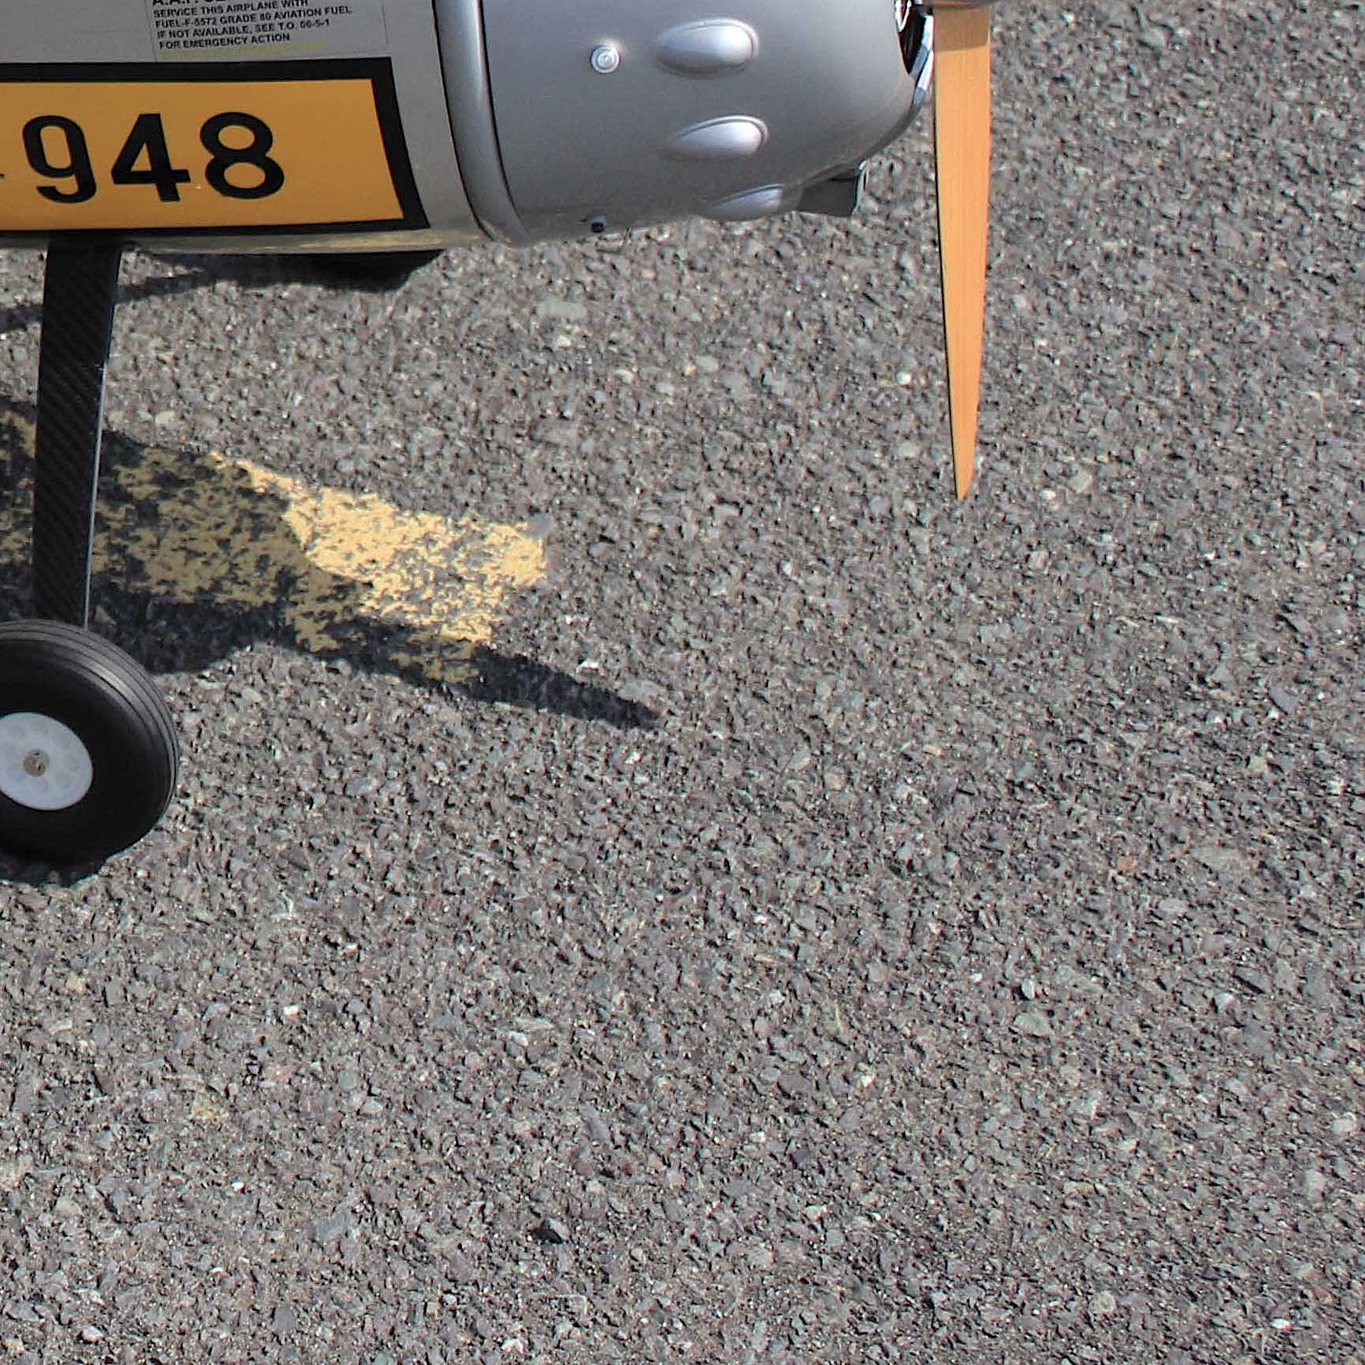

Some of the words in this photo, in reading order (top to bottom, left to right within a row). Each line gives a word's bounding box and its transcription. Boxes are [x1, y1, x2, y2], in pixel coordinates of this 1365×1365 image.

[153, 7, 198, 18] SERVICE
[201, 5, 224, 15] THIS
[226, 0, 278, 13] AIRPLANE
[220, 13, 258, 25] GRADE
[274, 8, 322, 20] AVIATION
[324, 5, 352, 16] FUEL
[157, 30, 166, 40] IF
[169, 28, 190, 39] NOT
[255, 23, 276, 33] SEE
[159, 40, 182, 50] FOR
[183, 36, 248, 49] EMERGENCY
[251, 33, 290, 45] ACTION
[21, 111, 286, 204] 948
